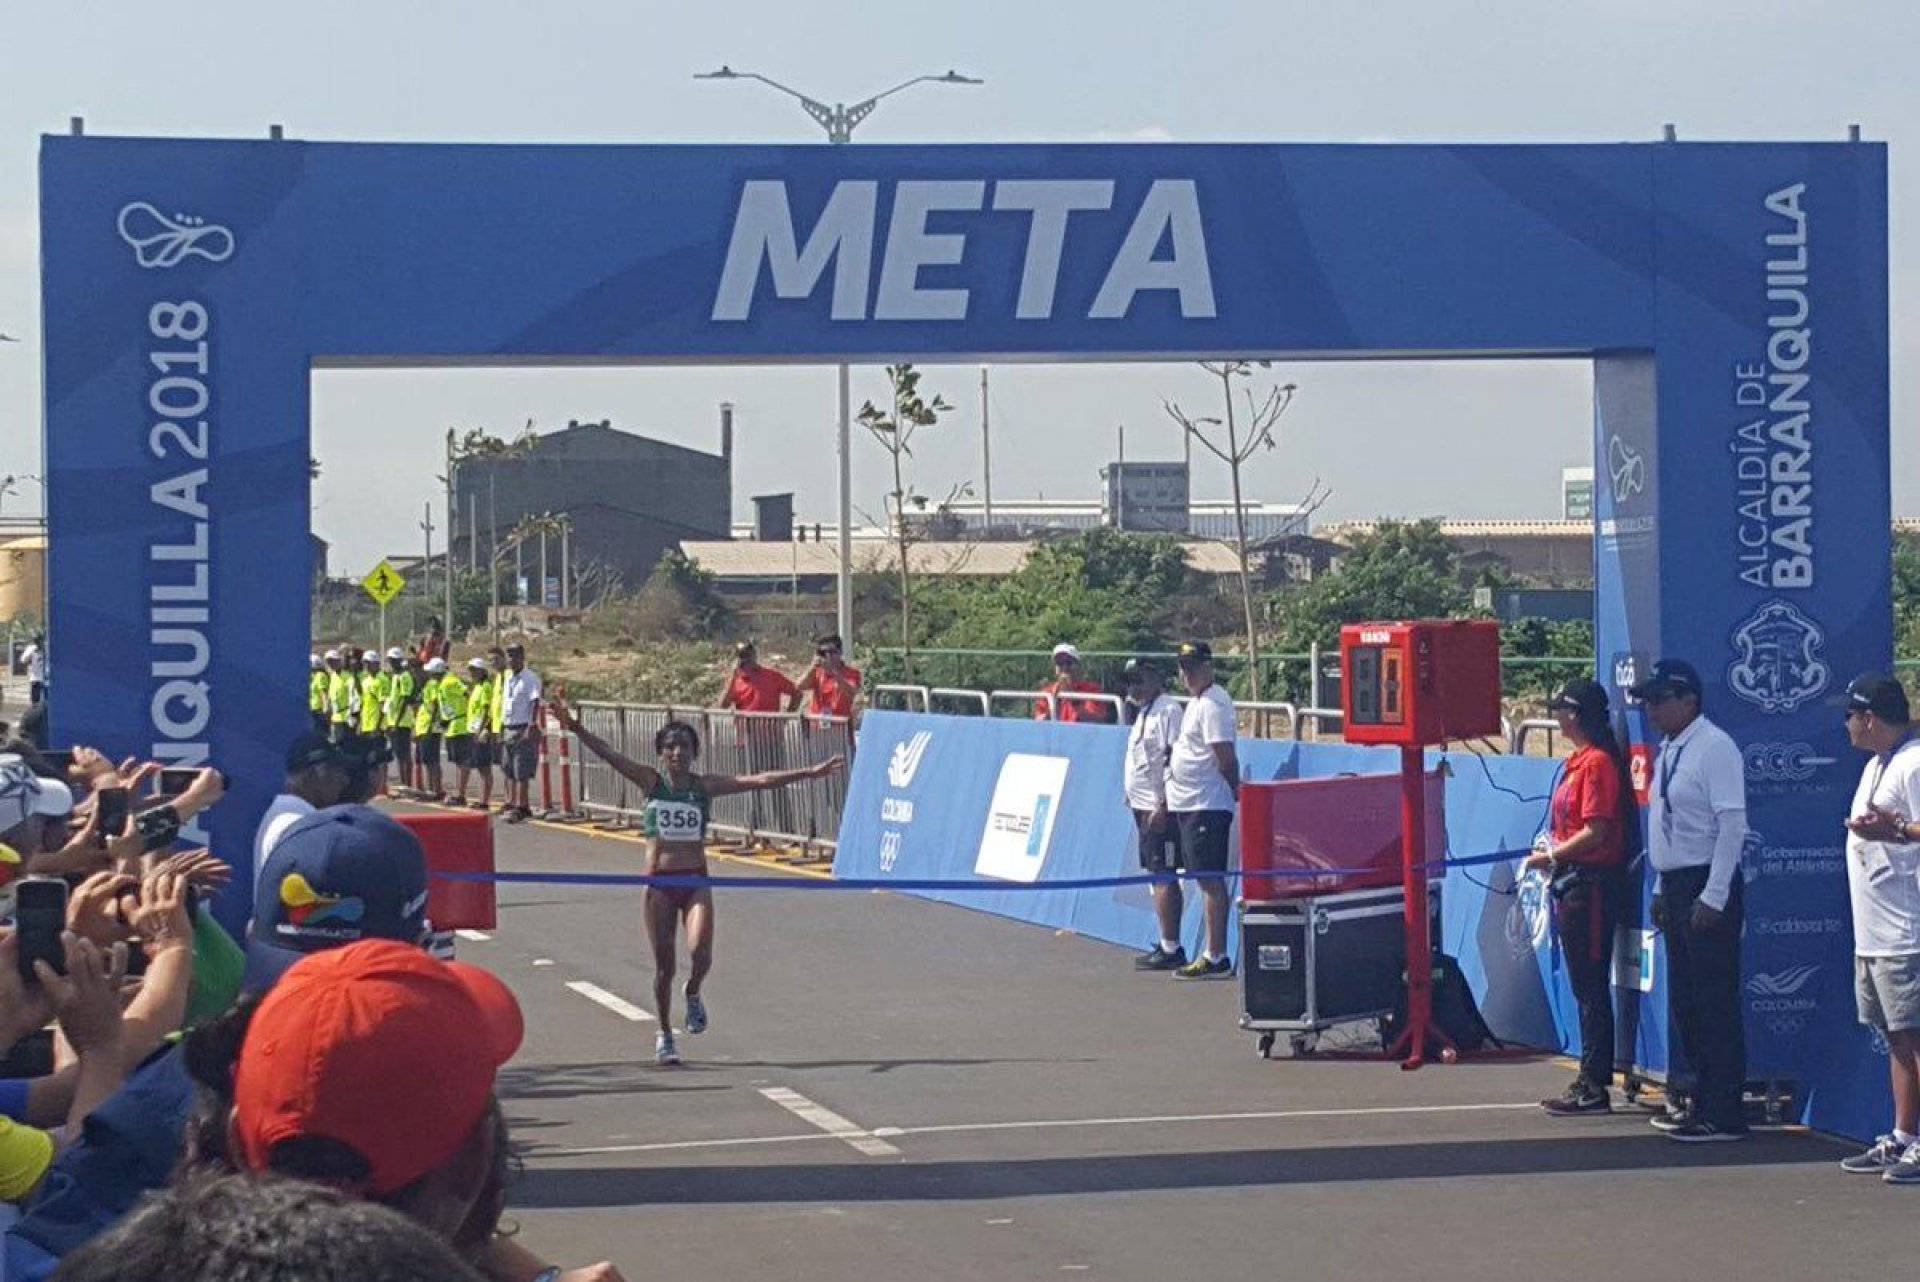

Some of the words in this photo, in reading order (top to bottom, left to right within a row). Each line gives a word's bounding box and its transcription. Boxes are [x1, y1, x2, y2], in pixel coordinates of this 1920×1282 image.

[711, 178, 1217, 321] META
[1736, 363, 1766, 406] DE
[1765, 182, 1813, 588] BARRANQUILLA
[1730, 420, 1769, 588] ALCALDÍA
[660, 809, 698, 828] 358
